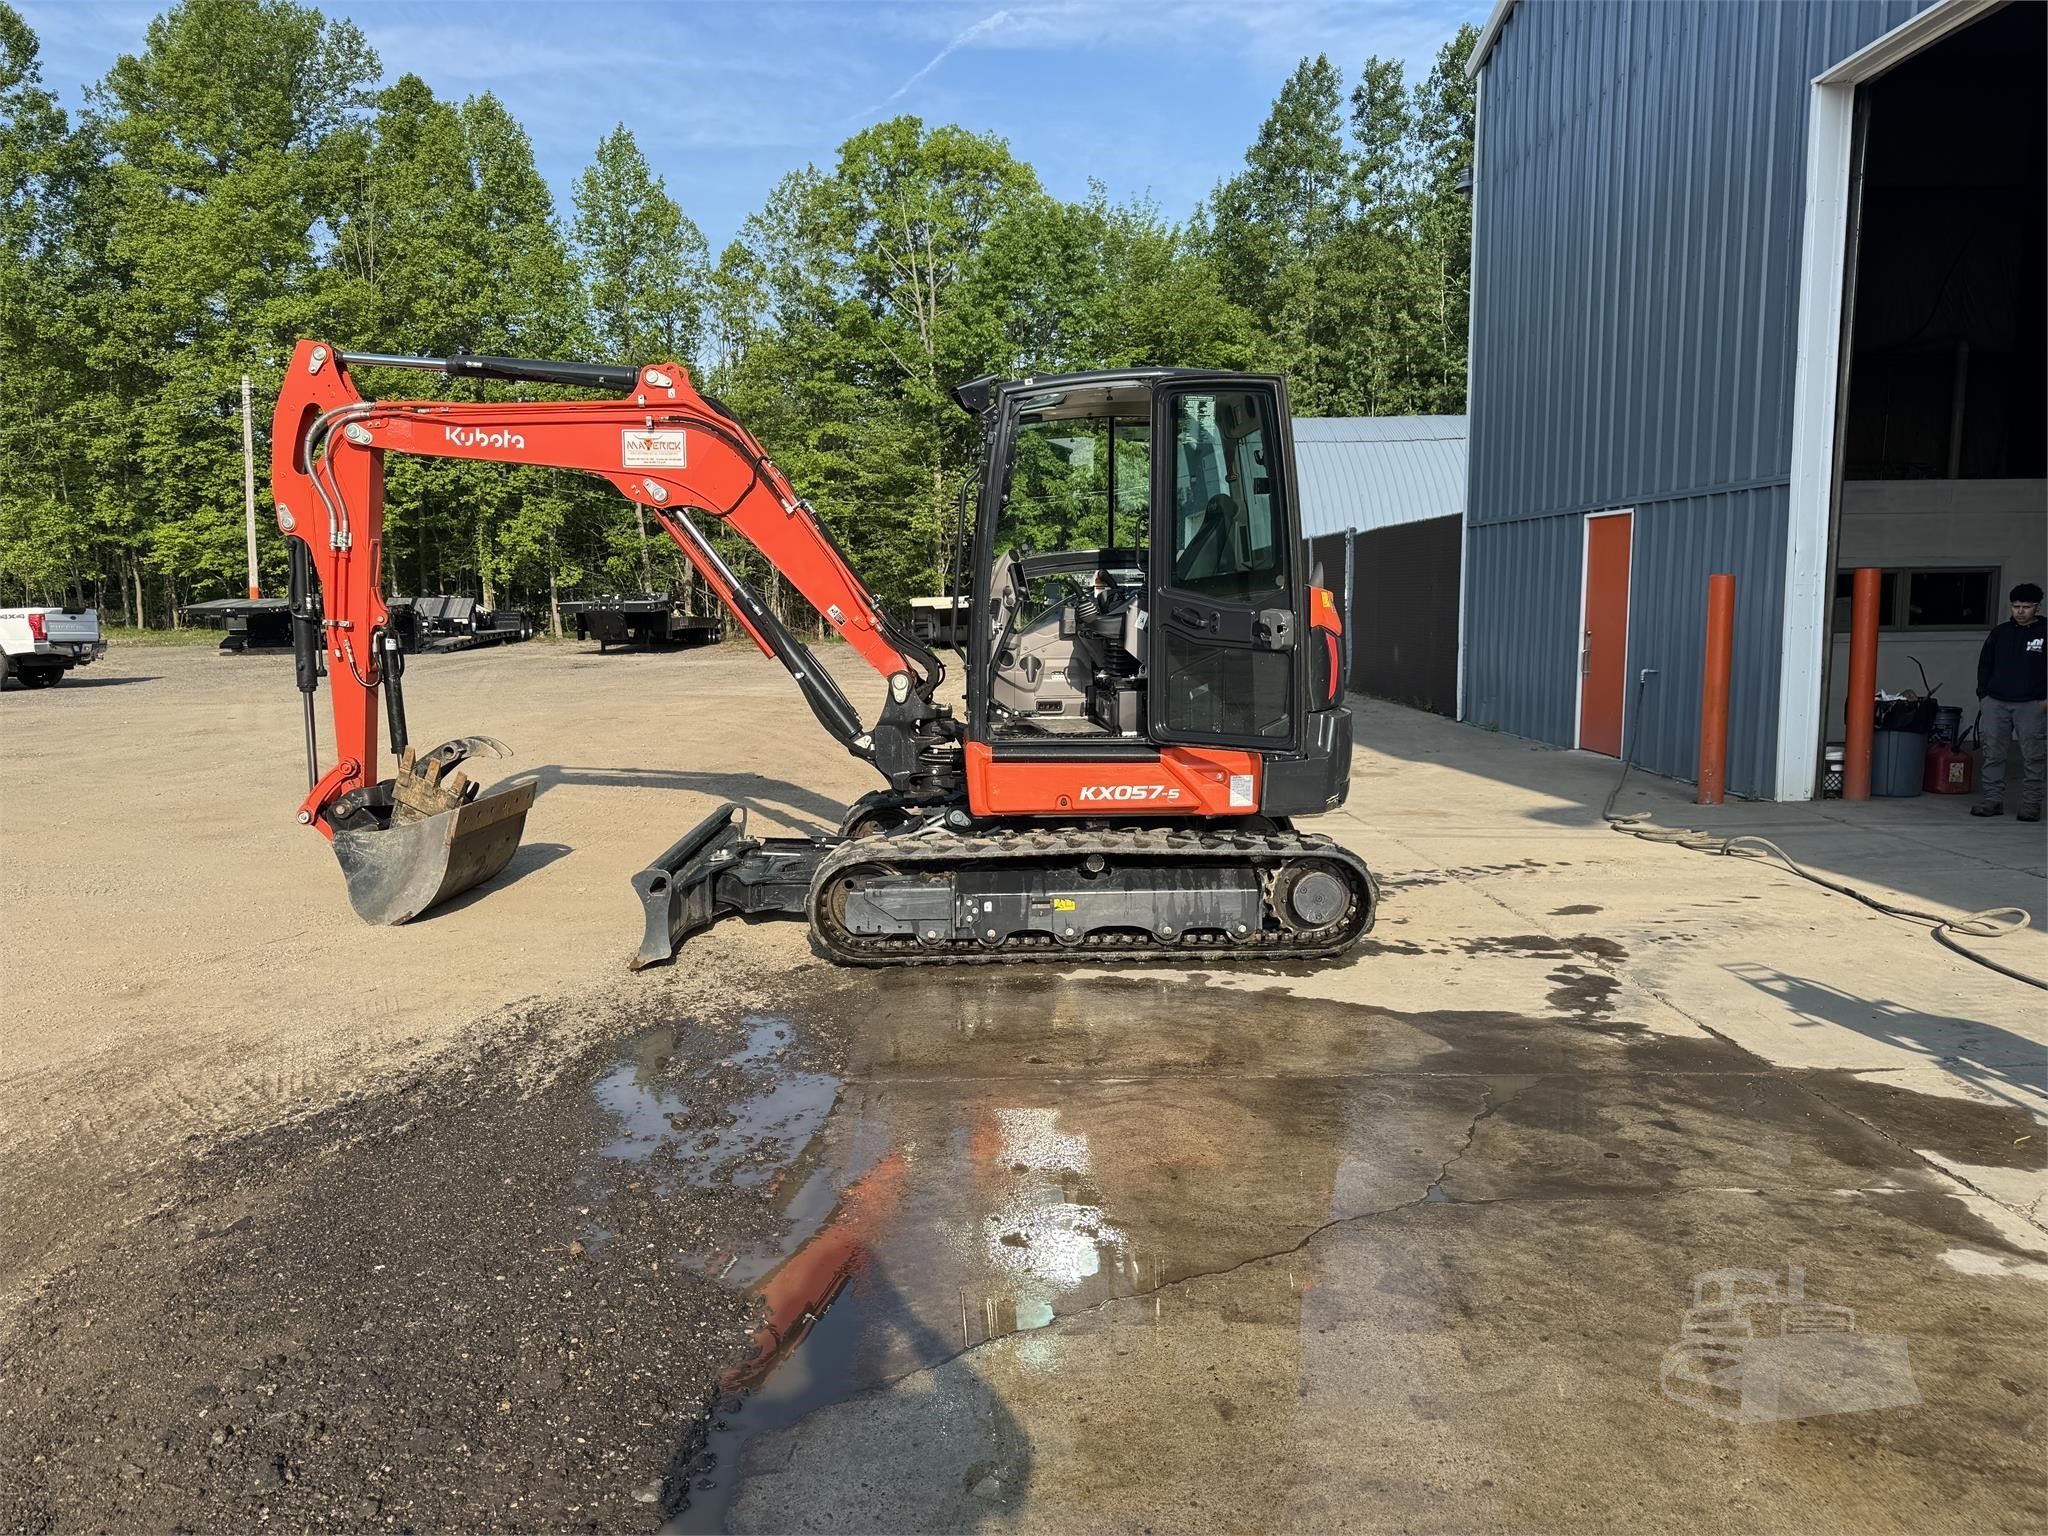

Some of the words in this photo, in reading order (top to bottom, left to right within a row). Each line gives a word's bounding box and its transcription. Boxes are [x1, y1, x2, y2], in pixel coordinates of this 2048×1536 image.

[446, 426, 524, 449] Kubota
[627, 440, 681, 450] MAVERICK
[1079, 785, 1180, 800] KX057-5
